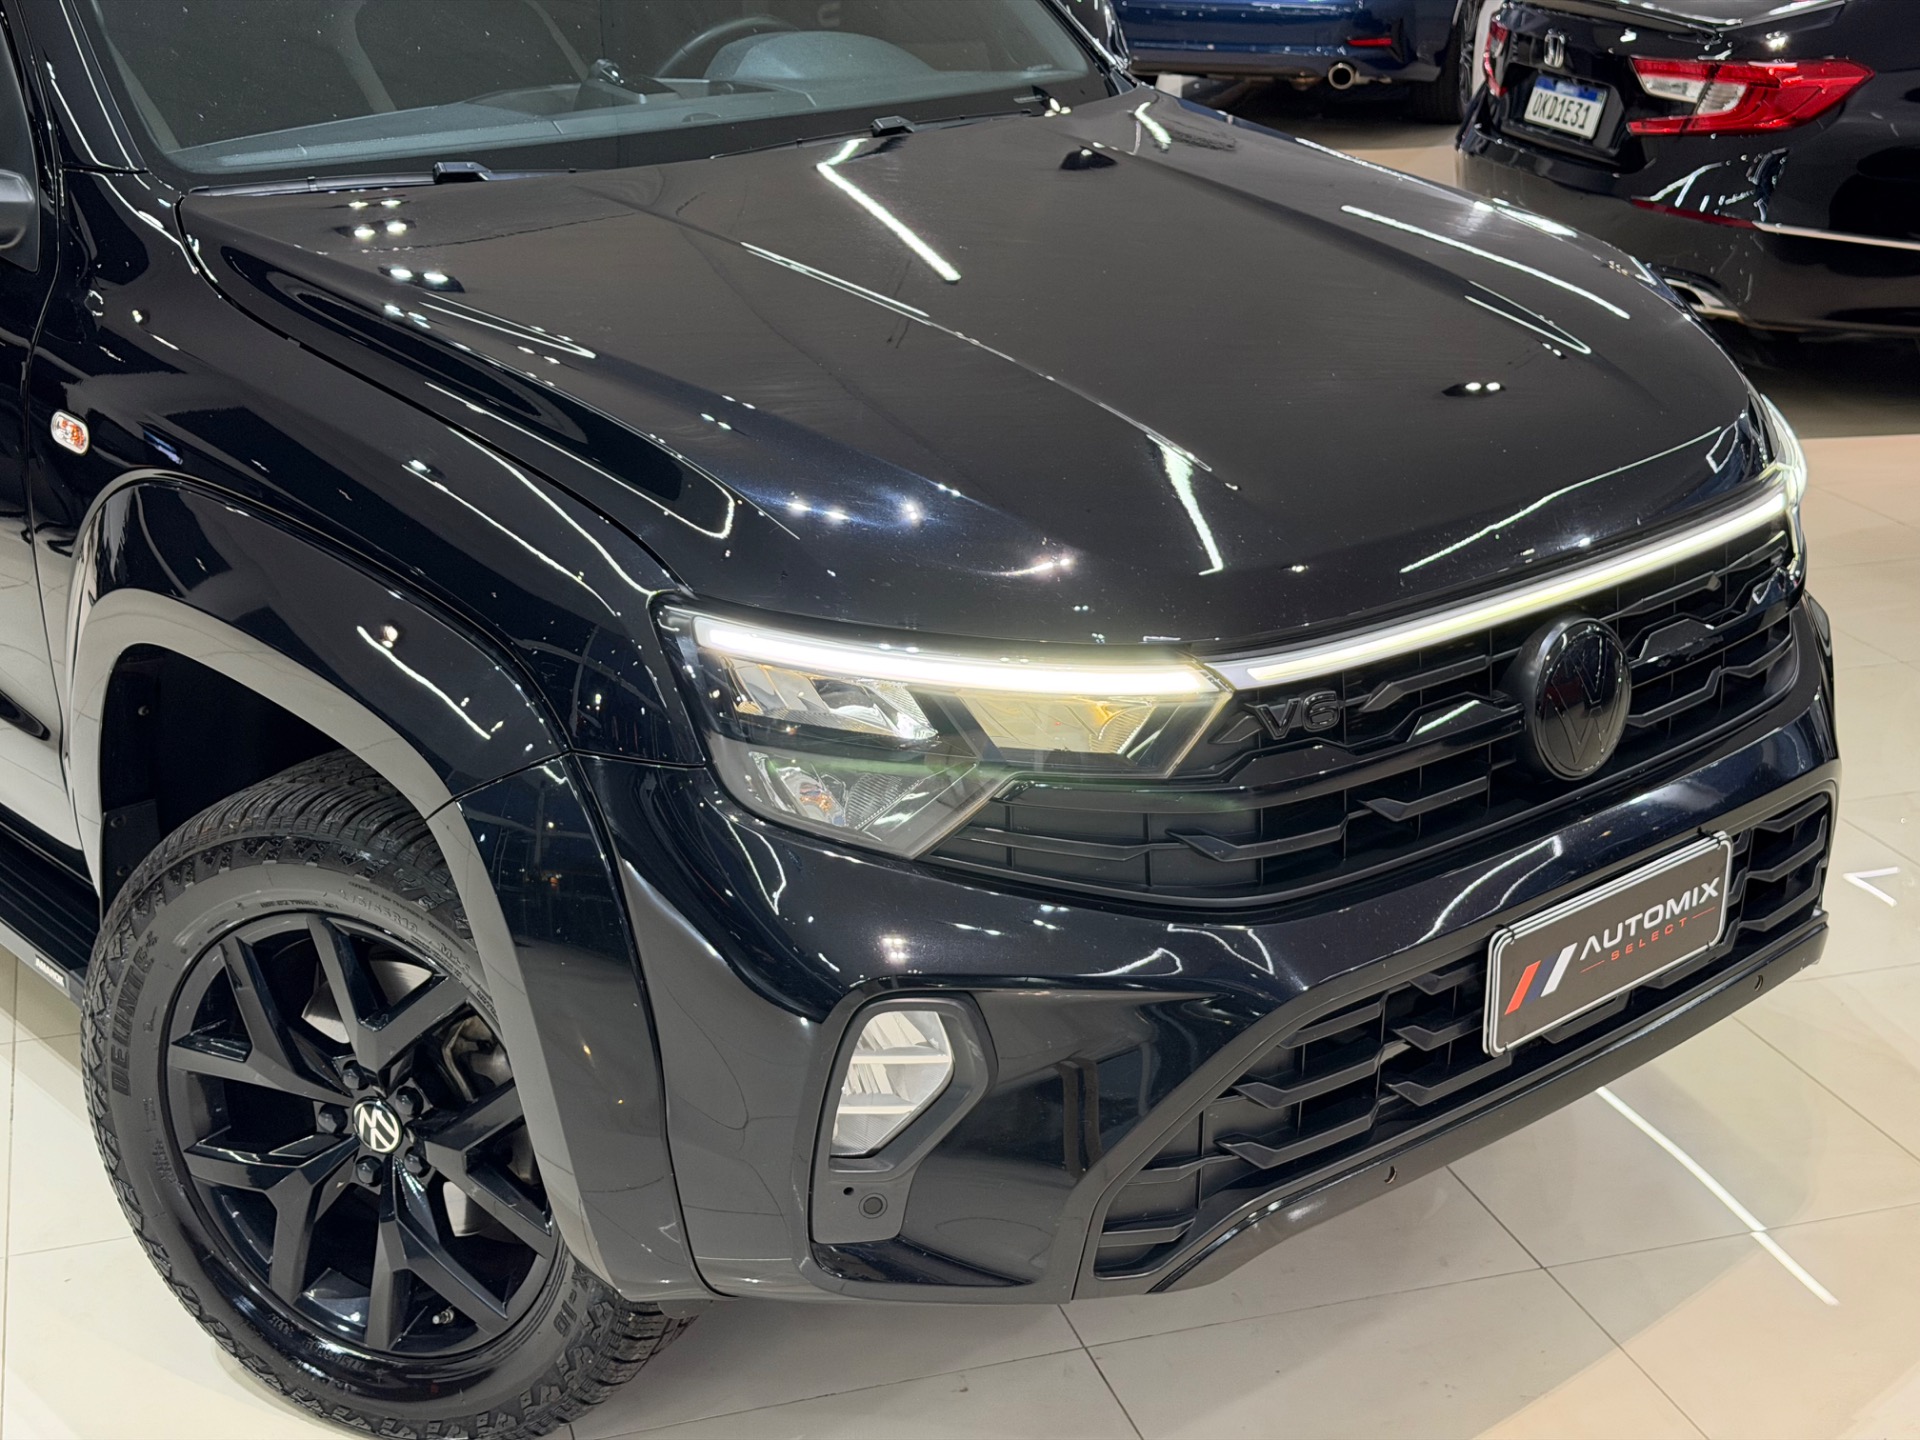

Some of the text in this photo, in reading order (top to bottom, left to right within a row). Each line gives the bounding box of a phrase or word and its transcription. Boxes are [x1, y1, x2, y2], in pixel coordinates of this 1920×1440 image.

[1255, 690, 1340, 740] V6
[1580, 877, 1720, 961] AUTOMIX
[1610, 917, 1688, 961] SELECT
